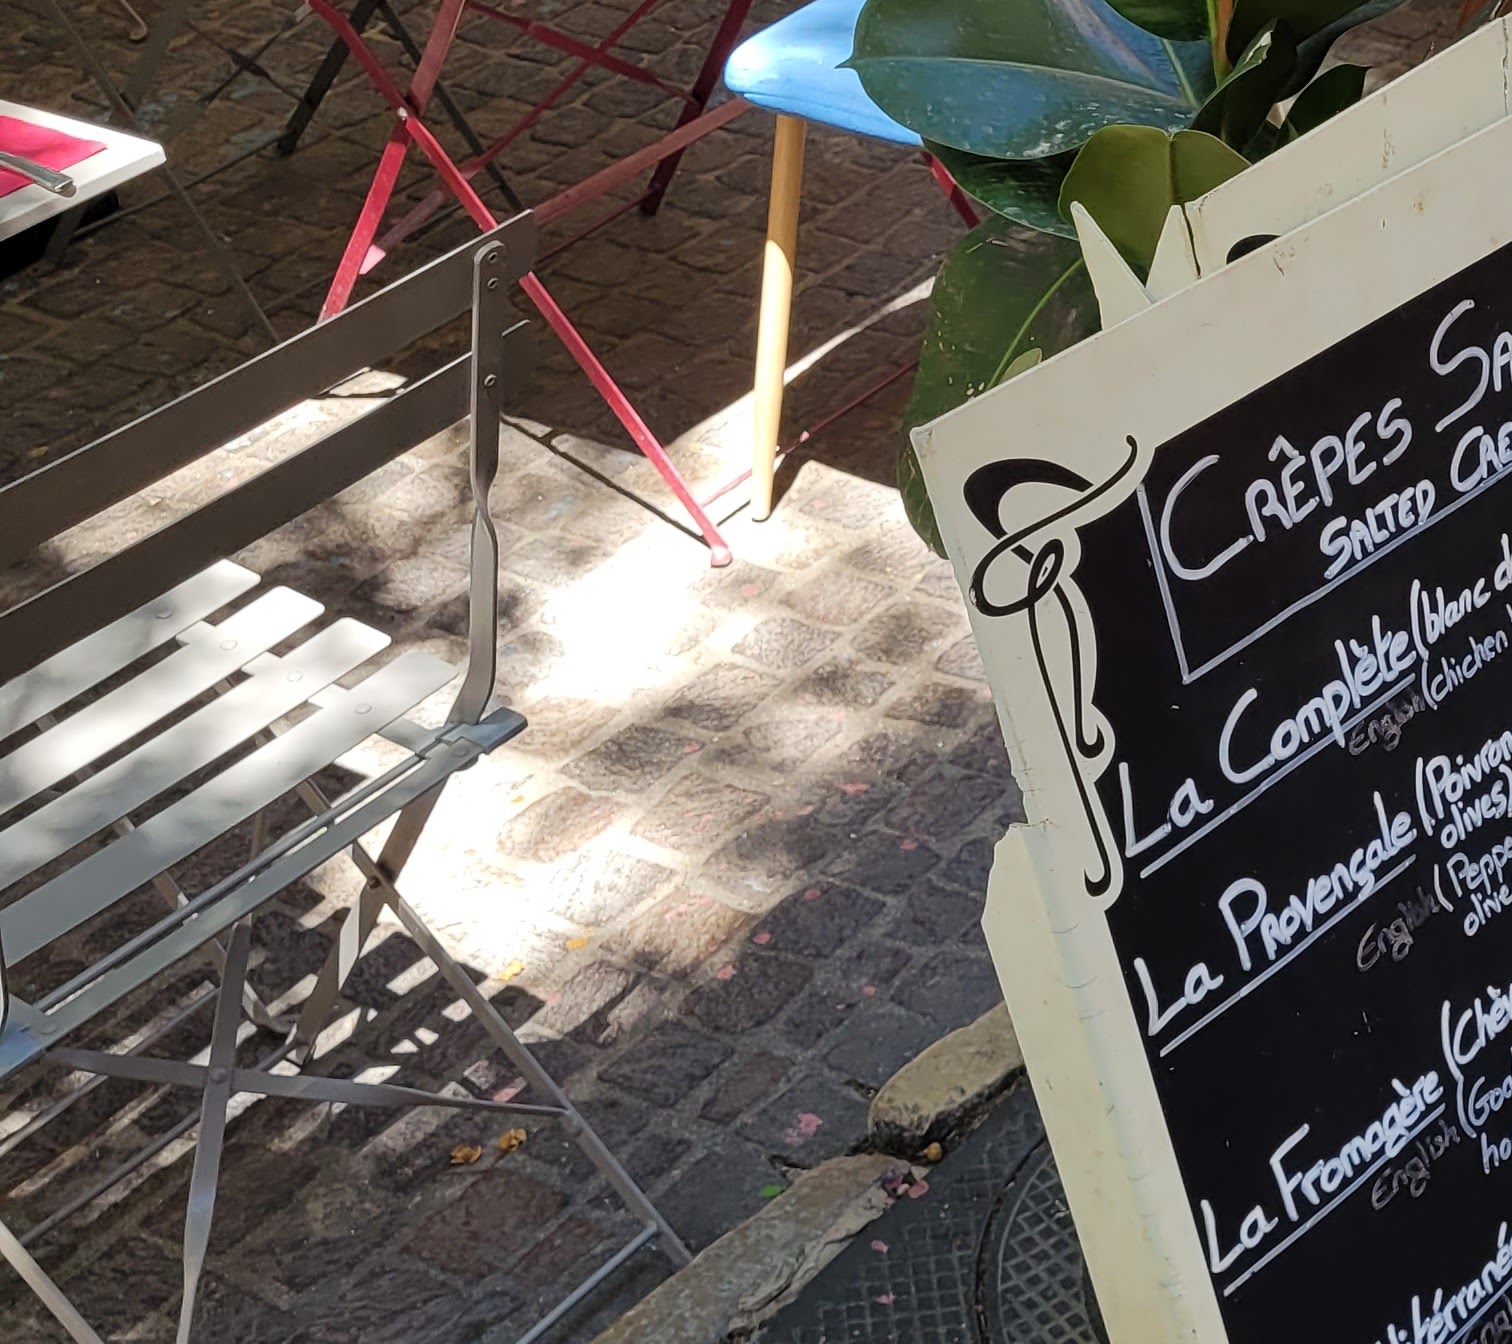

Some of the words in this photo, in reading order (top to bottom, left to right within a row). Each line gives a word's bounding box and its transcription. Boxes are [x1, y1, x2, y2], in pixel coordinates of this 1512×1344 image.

[1160, 397, 1413, 581] CRÊPES
[1319, 479, 1436, 580] SALTED
[1118, 761, 1215, 858] La
[1218, 614, 1417, 784] Complète
[1133, 957, 1224, 1036] La
[1200, 1199, 1279, 1274] La
[1269, 1070, 1444, 1222] Fromagère
